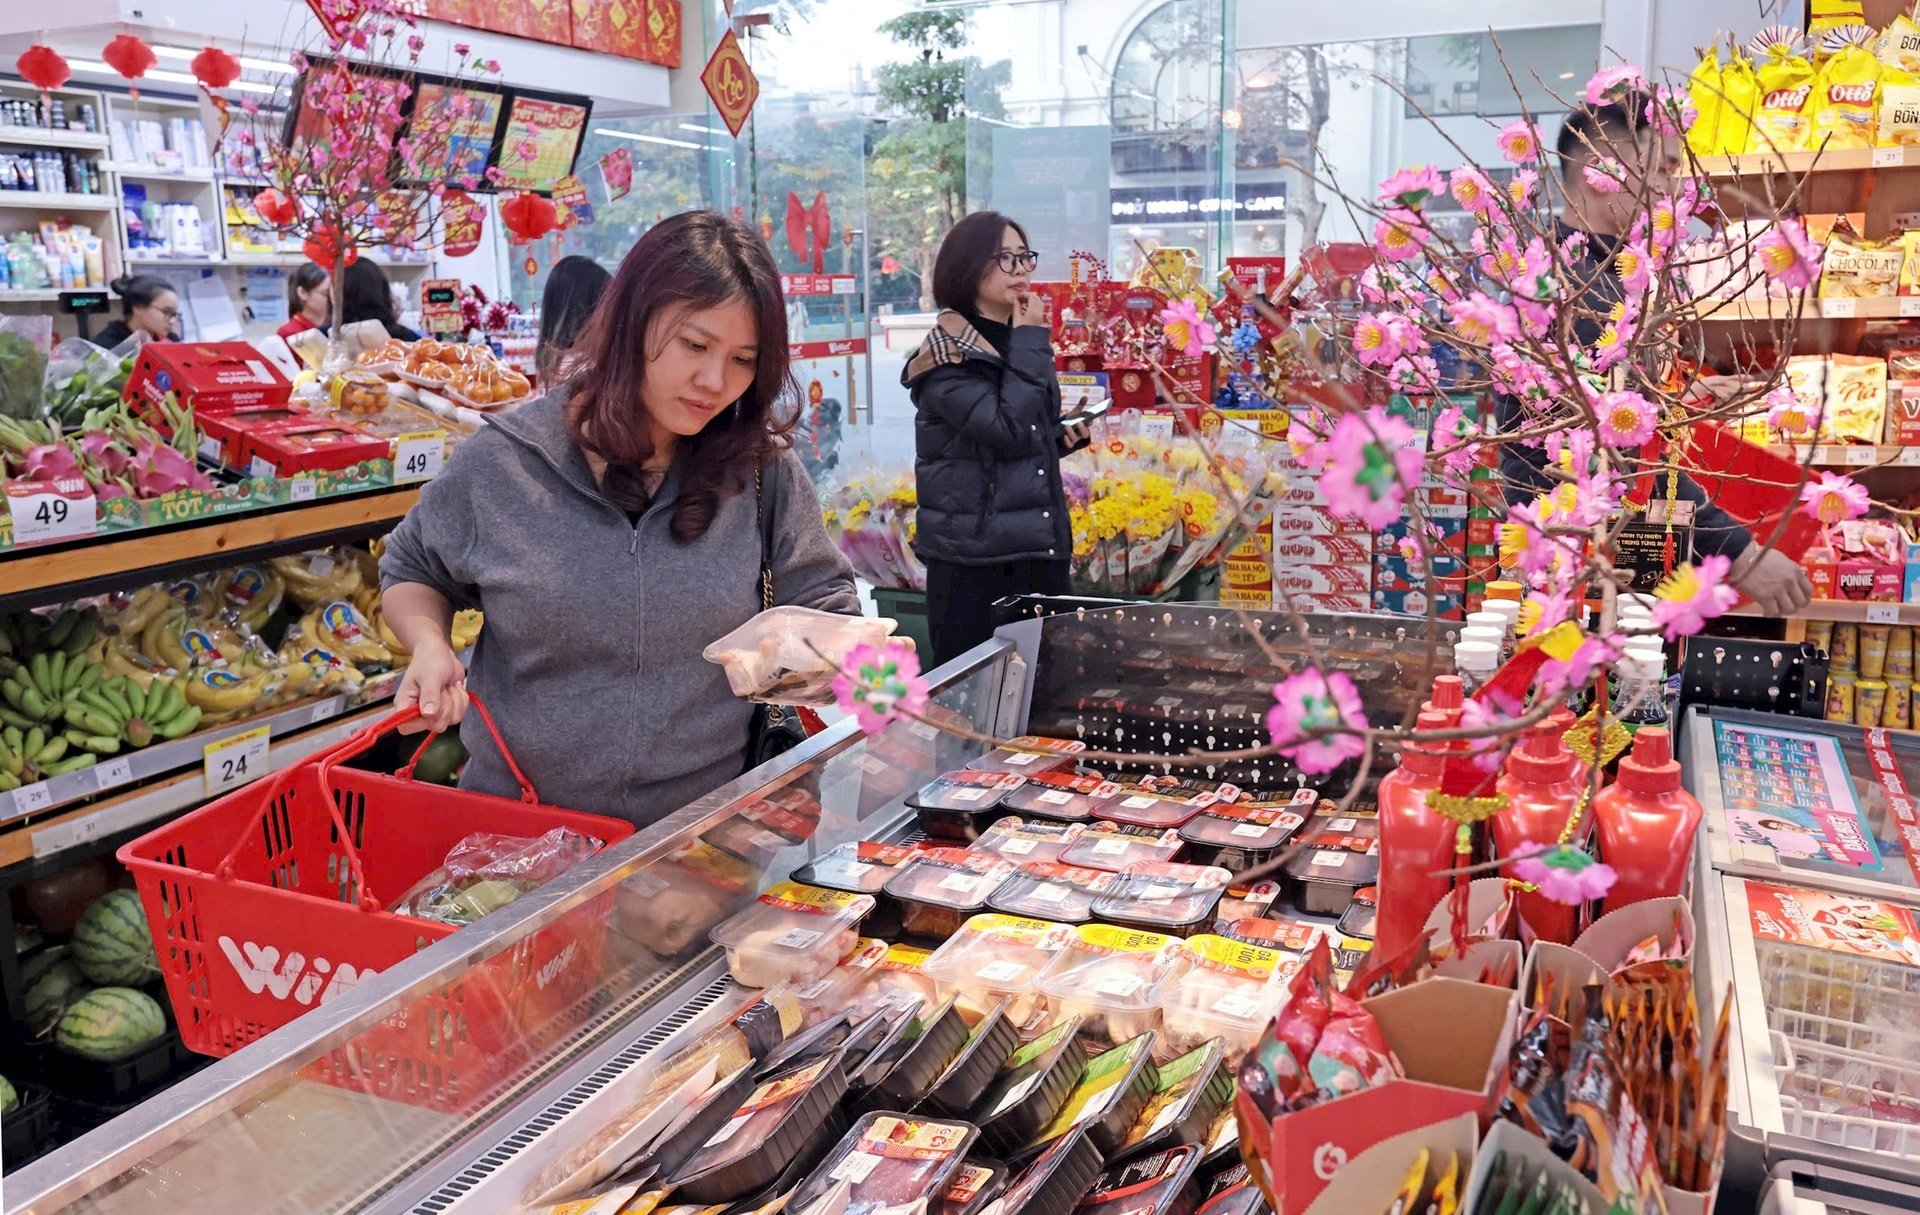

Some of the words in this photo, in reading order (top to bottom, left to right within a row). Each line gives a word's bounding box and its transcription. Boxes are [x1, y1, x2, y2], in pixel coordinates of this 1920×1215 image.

[1765, 88, 1805, 109] Otto
[1832, 82, 1872, 102] Otto
[406, 453, 427, 474] 49
[35, 499, 68, 525] 49
[162, 496, 203, 521] TỐT
[1840, 573, 1874, 586] PONNIE
[111, 768, 122, 777] 41
[222, 754, 248, 782] 24
[30, 791, 42, 802] 29
[1256, 949, 1272, 961] GÀ
